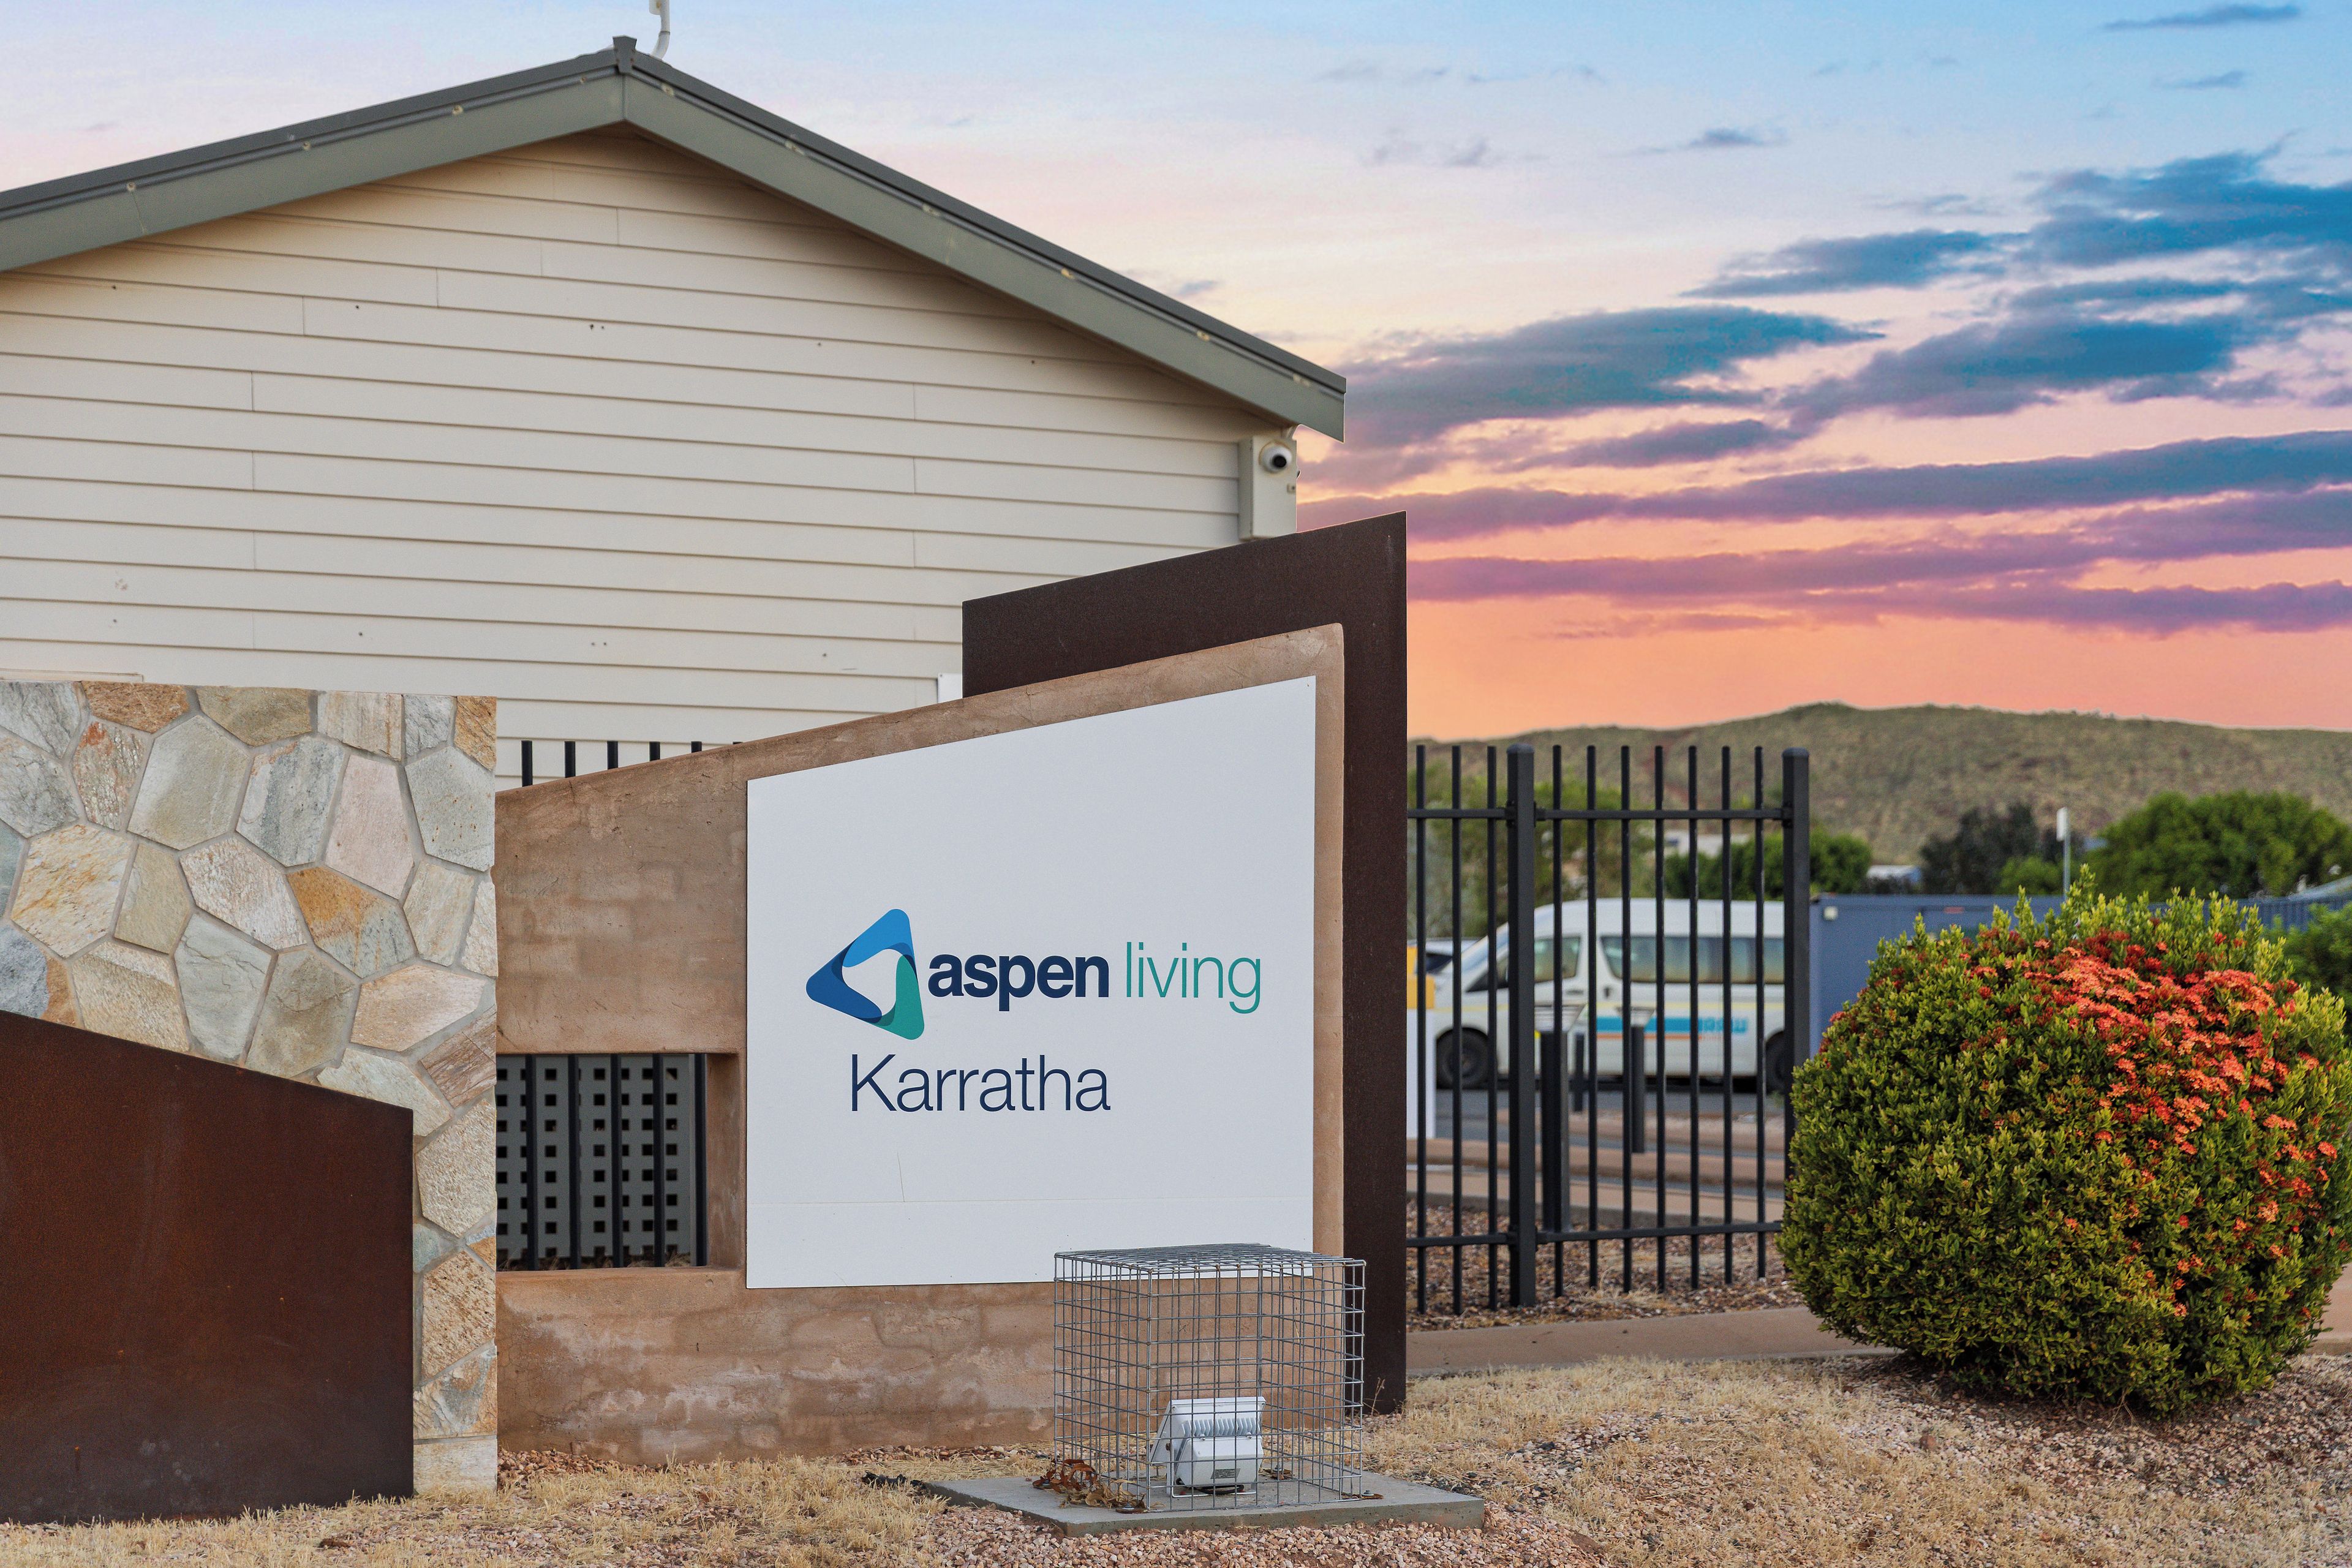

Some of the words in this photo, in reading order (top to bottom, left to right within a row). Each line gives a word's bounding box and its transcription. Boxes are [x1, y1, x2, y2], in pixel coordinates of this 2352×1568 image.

[928, 954, 1109, 1012] aspen
[1125, 941, 1261, 1014] living
[851, 1054, 1111, 1112] Karratha
